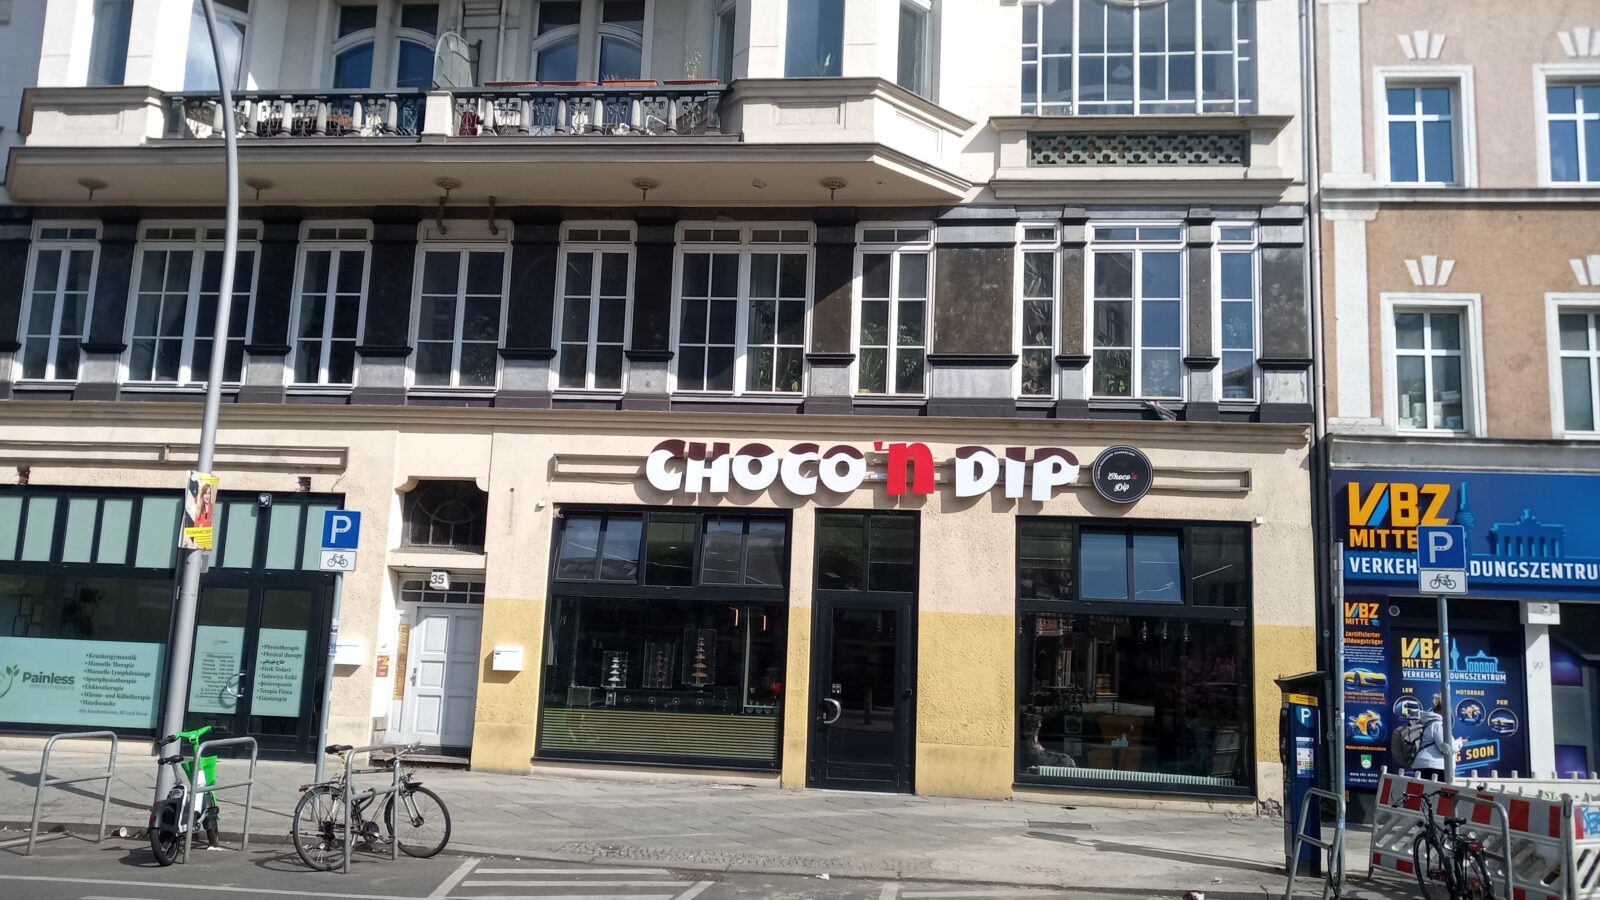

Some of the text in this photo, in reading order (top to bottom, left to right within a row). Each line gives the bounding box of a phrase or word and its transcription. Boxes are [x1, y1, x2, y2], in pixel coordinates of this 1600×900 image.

[646, 439, 867, 496] CHOCO
[955, 445, 1080, 501] DIP
[1113, 482, 1130, 492] Dip
[1348, 482, 1450, 527] VBZ
[330, 515, 352, 544] P
[1349, 529, 1418, 550] MITTE
[1428, 531, 1454, 564] P
[431, 574, 445, 585] 35
[1344, 602, 1379, 619] VBZ
[1345, 618, 1370, 626] MITTE
[1402, 659, 1433, 669] MITTE
[22, 671, 75, 686] Painless
[1301, 707, 1312, 724] P
[1466, 745, 1495, 761] SOON
